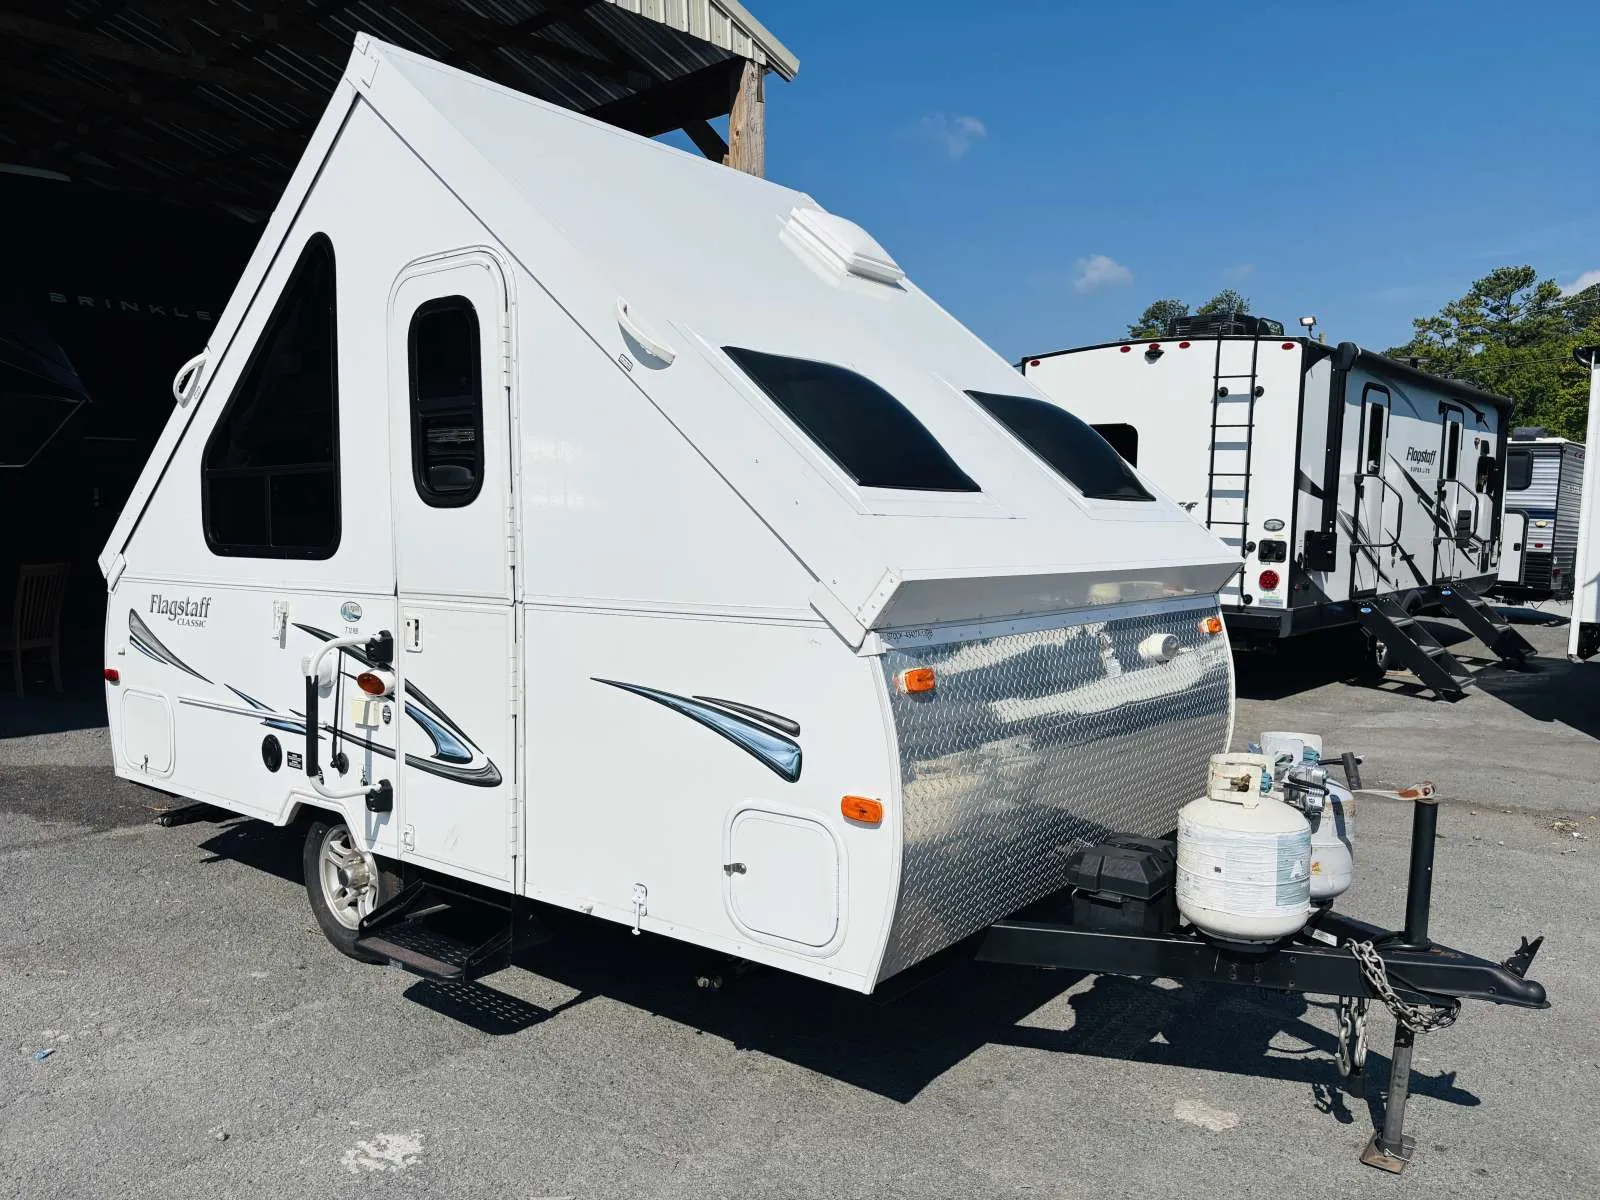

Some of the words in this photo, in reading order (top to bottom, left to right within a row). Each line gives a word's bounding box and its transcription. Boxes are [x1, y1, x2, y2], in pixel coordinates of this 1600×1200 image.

[48, 291, 221, 321] BRINKLE
[1406, 446, 1437, 466] Flagstaff
[150, 594, 212, 621] Flagstaff
[177, 618, 207, 628] CLASSIC
